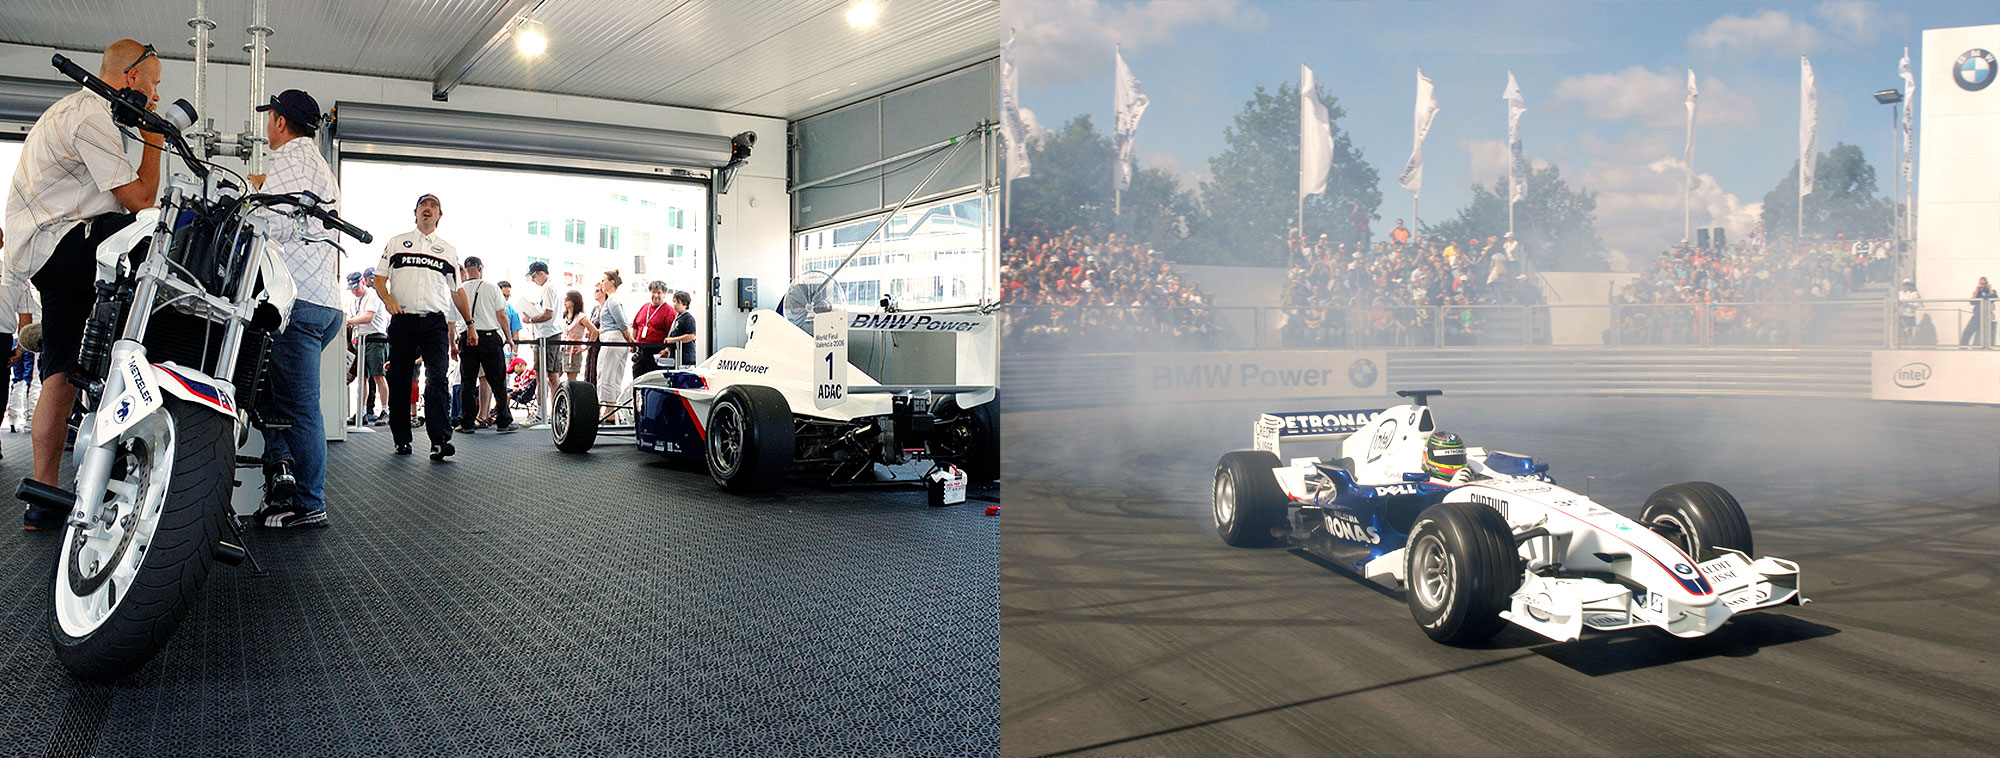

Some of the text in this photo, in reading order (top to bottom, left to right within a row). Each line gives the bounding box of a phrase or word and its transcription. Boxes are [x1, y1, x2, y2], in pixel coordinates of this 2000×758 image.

[401, 256, 444, 269] PETRONAS
[851, 314, 979, 331] BMW Power
[717, 360, 769, 374] BMW Power
[825, 351, 833, 380] 1
[1152, 364, 1233, 389] BMW
[1239, 363, 1333, 388] Power
[818, 384, 842, 399] ADAC
[1375, 484, 1417, 497] DELL
